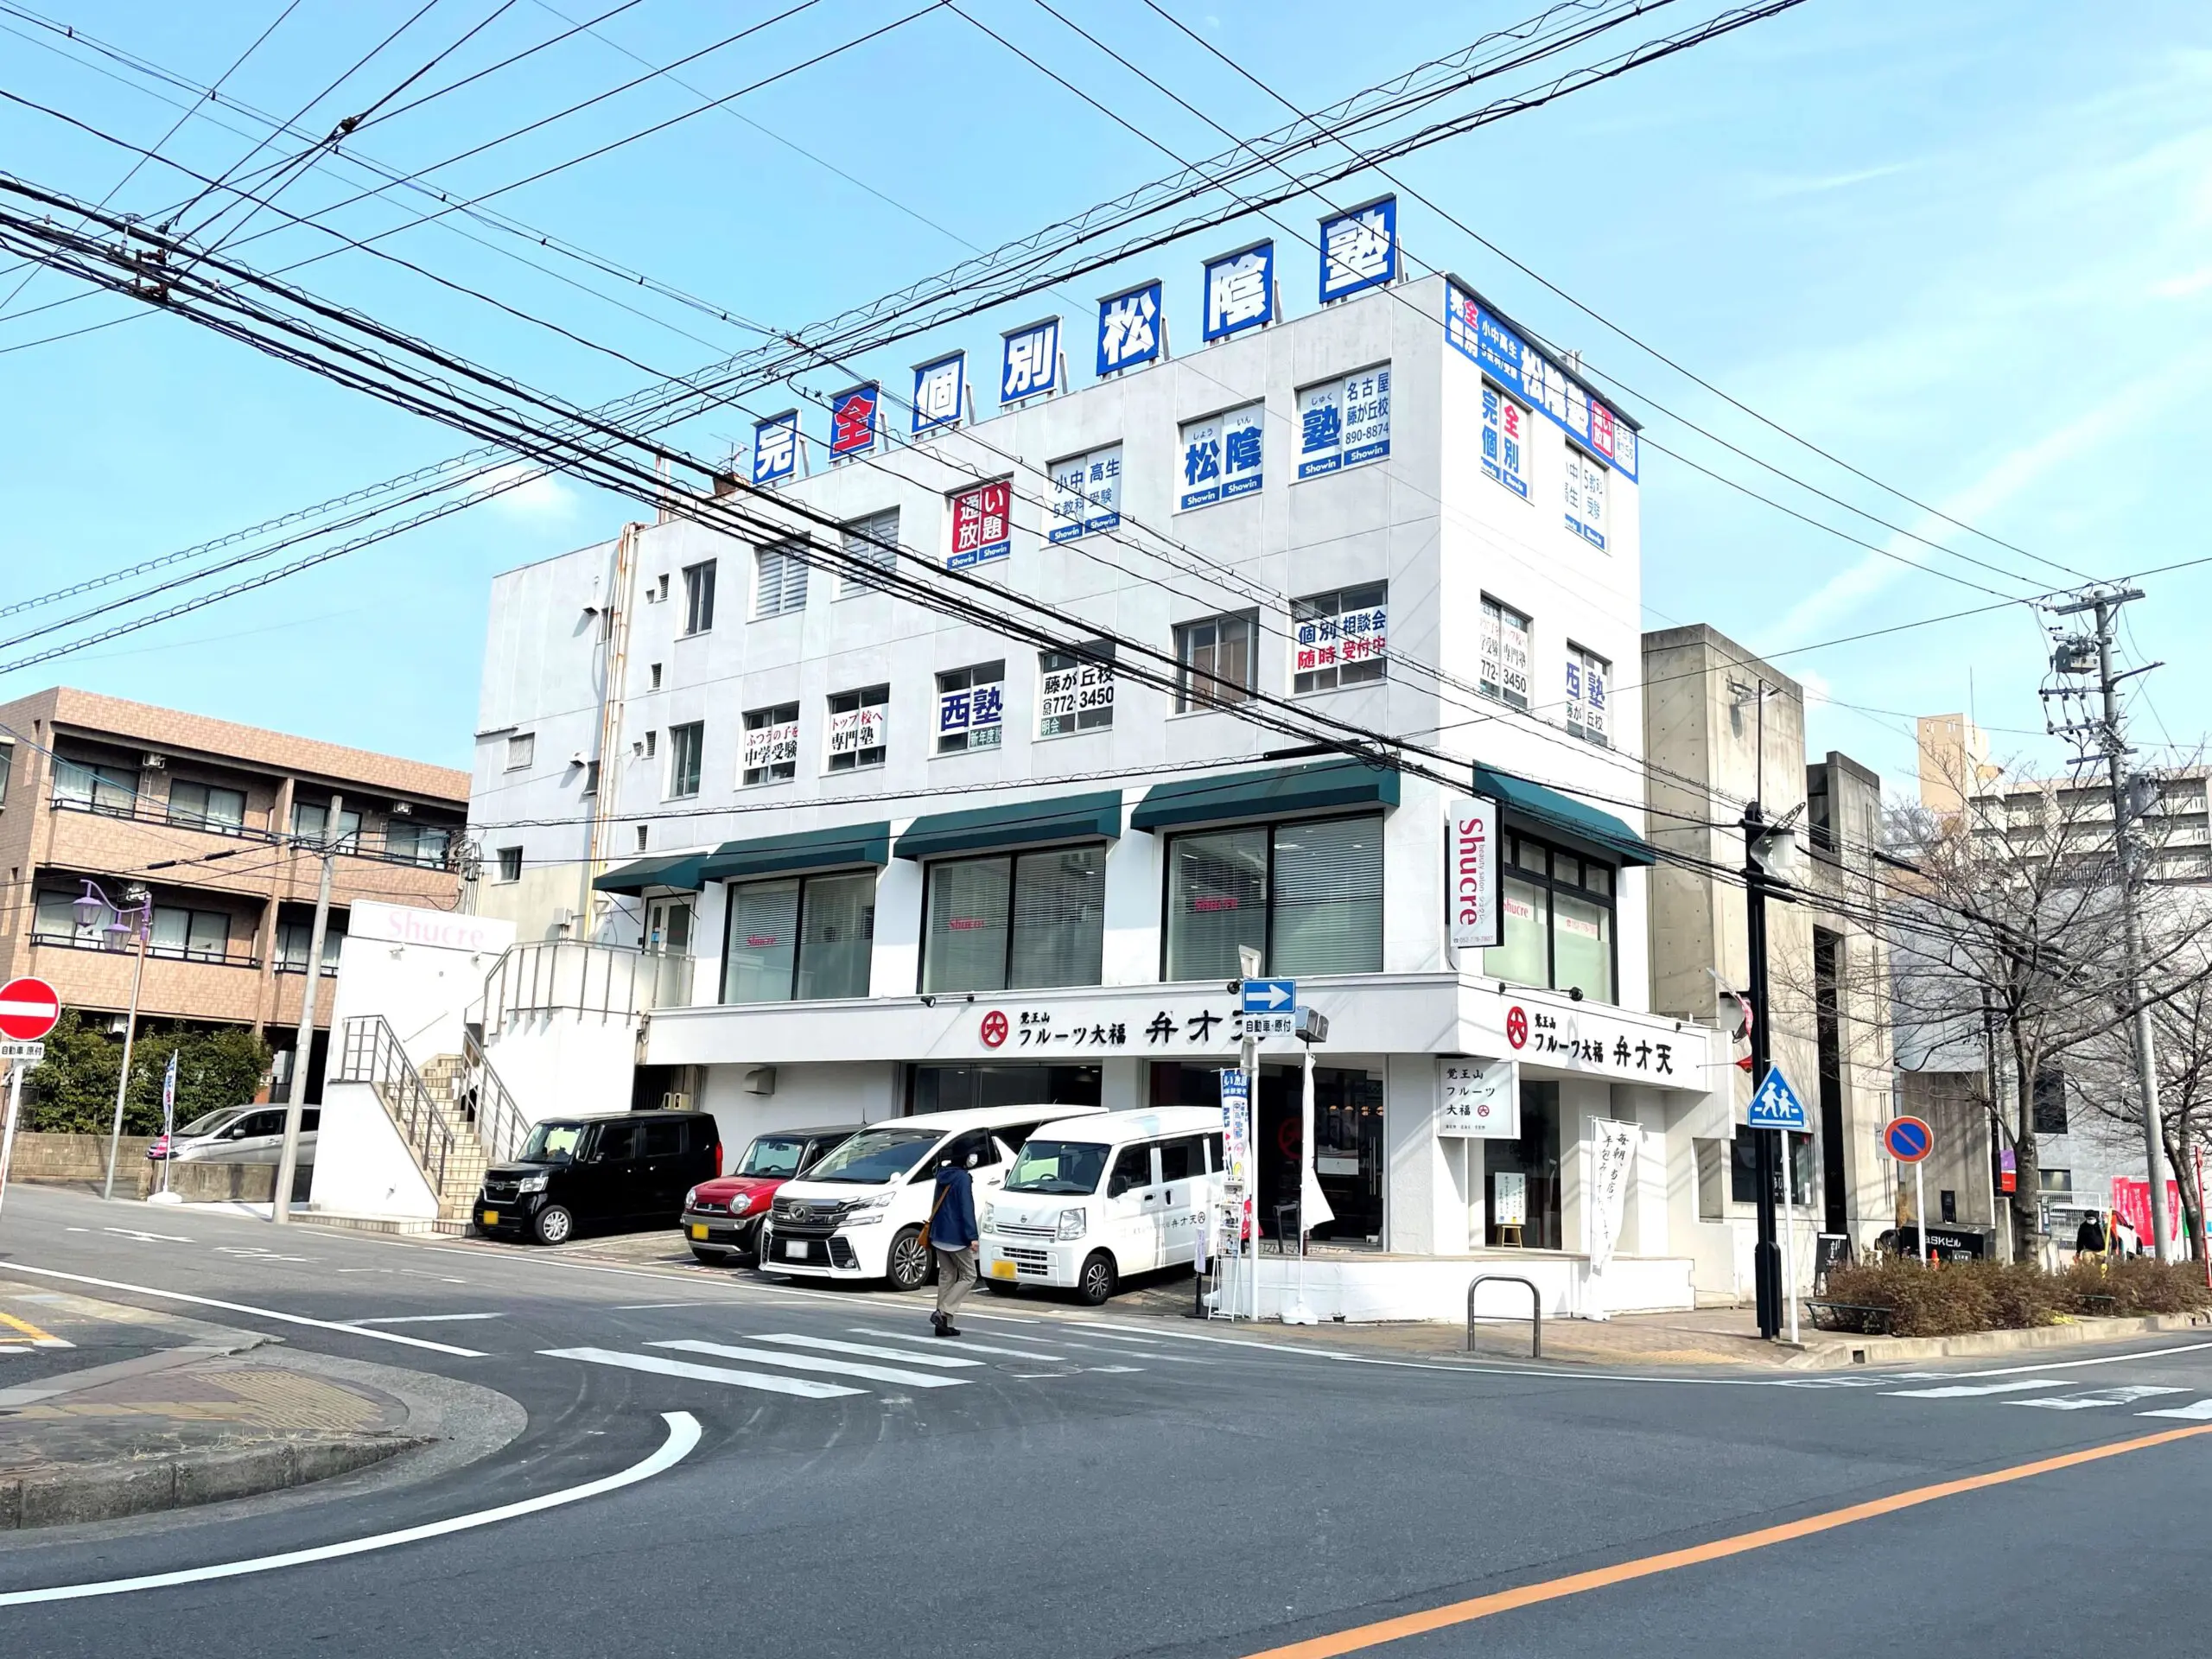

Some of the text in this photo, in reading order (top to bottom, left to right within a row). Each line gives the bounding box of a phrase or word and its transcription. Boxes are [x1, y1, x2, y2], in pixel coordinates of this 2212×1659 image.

[1347, 372, 1389, 402] 名古屋
[1311, 392, 1332, 406] じゅく
[1346, 397, 1389, 427] 藤が丘校
[1302, 404, 1341, 454] 塾
[1345, 423, 1389, 445] 890-8874
[1185, 426, 1262, 486] 松陰
[1351, 446, 1383, 461] Showin
[1305, 459, 1337, 474] Showin
[1228, 479, 1257, 493] Showin
[960, 489, 1004, 522] 通い
[1187, 491, 1216, 505] Showin
[958, 514, 1002, 550] 放題
[1054, 527, 1079, 540] Showin
[1090, 516, 1116, 530] Showin
[952, 556, 974, 567] Showin
[984, 544, 1007, 557] Showin
[1044, 665, 1114, 695] 藤が丘校
[941, 686, 1003, 732] 西塾
[832, 726, 874, 751] 専門塾
[746, 741, 797, 766] 中学受験
[1459, 818, 1485, 925] Shucre
[389, 912, 484, 947] Shucre
[1020, 1012, 1050, 1024] 覚王山
[1246, 1020, 1292, 1033] 自動車・原付
[1020, 1023, 1126, 1046] フルーツ大福
[1535, 1033, 1673, 1075] フルーツ大福 弁才天
[1446, 1068, 1484, 1079] 覚王山
[1446, 1087, 1495, 1097] フルーツ
[1446, 1104, 1471, 1116] 大福
